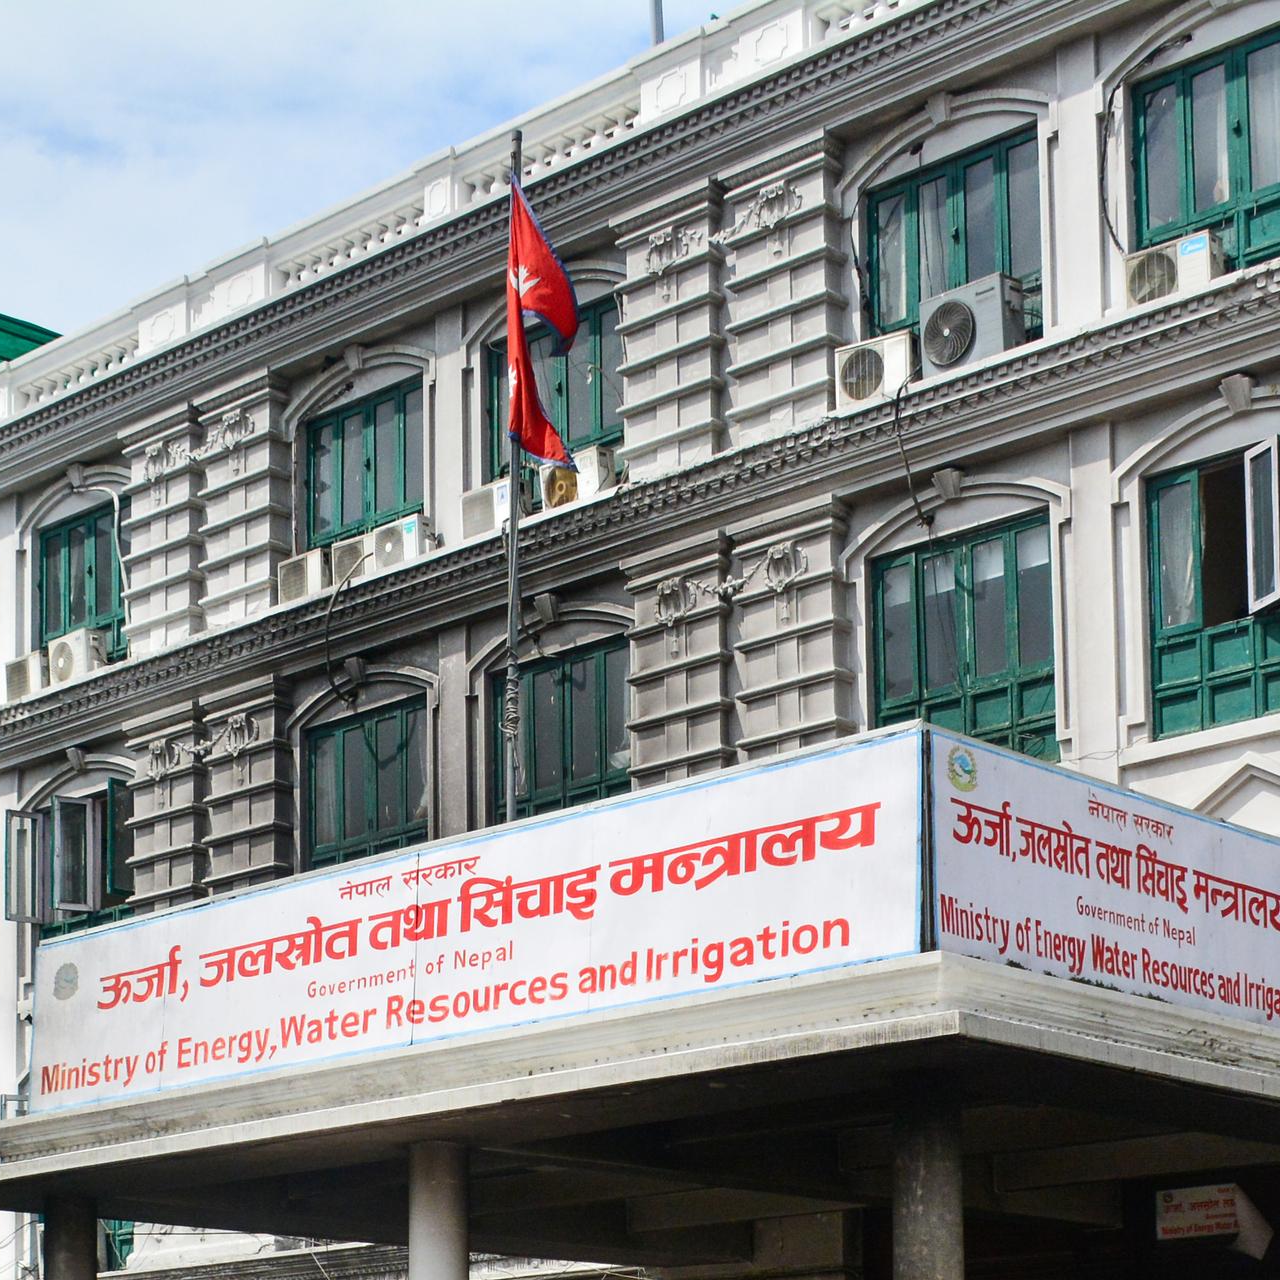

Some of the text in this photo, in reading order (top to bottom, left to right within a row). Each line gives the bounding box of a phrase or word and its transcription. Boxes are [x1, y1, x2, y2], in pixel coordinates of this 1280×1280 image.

[1087, 792, 1175, 845] नेपाल सरकार
[338, 856, 483, 901] नेपाल सरकार
[368, 898, 452, 951] तथा
[608, 802, 881, 896] मन्त्रालय
[1096, 841, 1133, 888] तथा
[1075, 895, 1196, 948] Government of Nepal
[308, 942, 513, 998] Government of Nepal
[940, 895, 1009, 955] Ministry
[1016, 918, 1031, 950] of
[1035, 920, 1086, 974] Energy
[1091, 934, 1138, 980] Water
[1141, 948, 1216, 1000] Resources
[1218, 972, 1242, 1006] and
[40, 1056, 140, 1094] Ministry
[145, 1041, 168, 1073] of
[386, 972, 569, 1028] Resources
[578, 954, 638, 993] and
[645, 918, 850, 983] Irrigation
